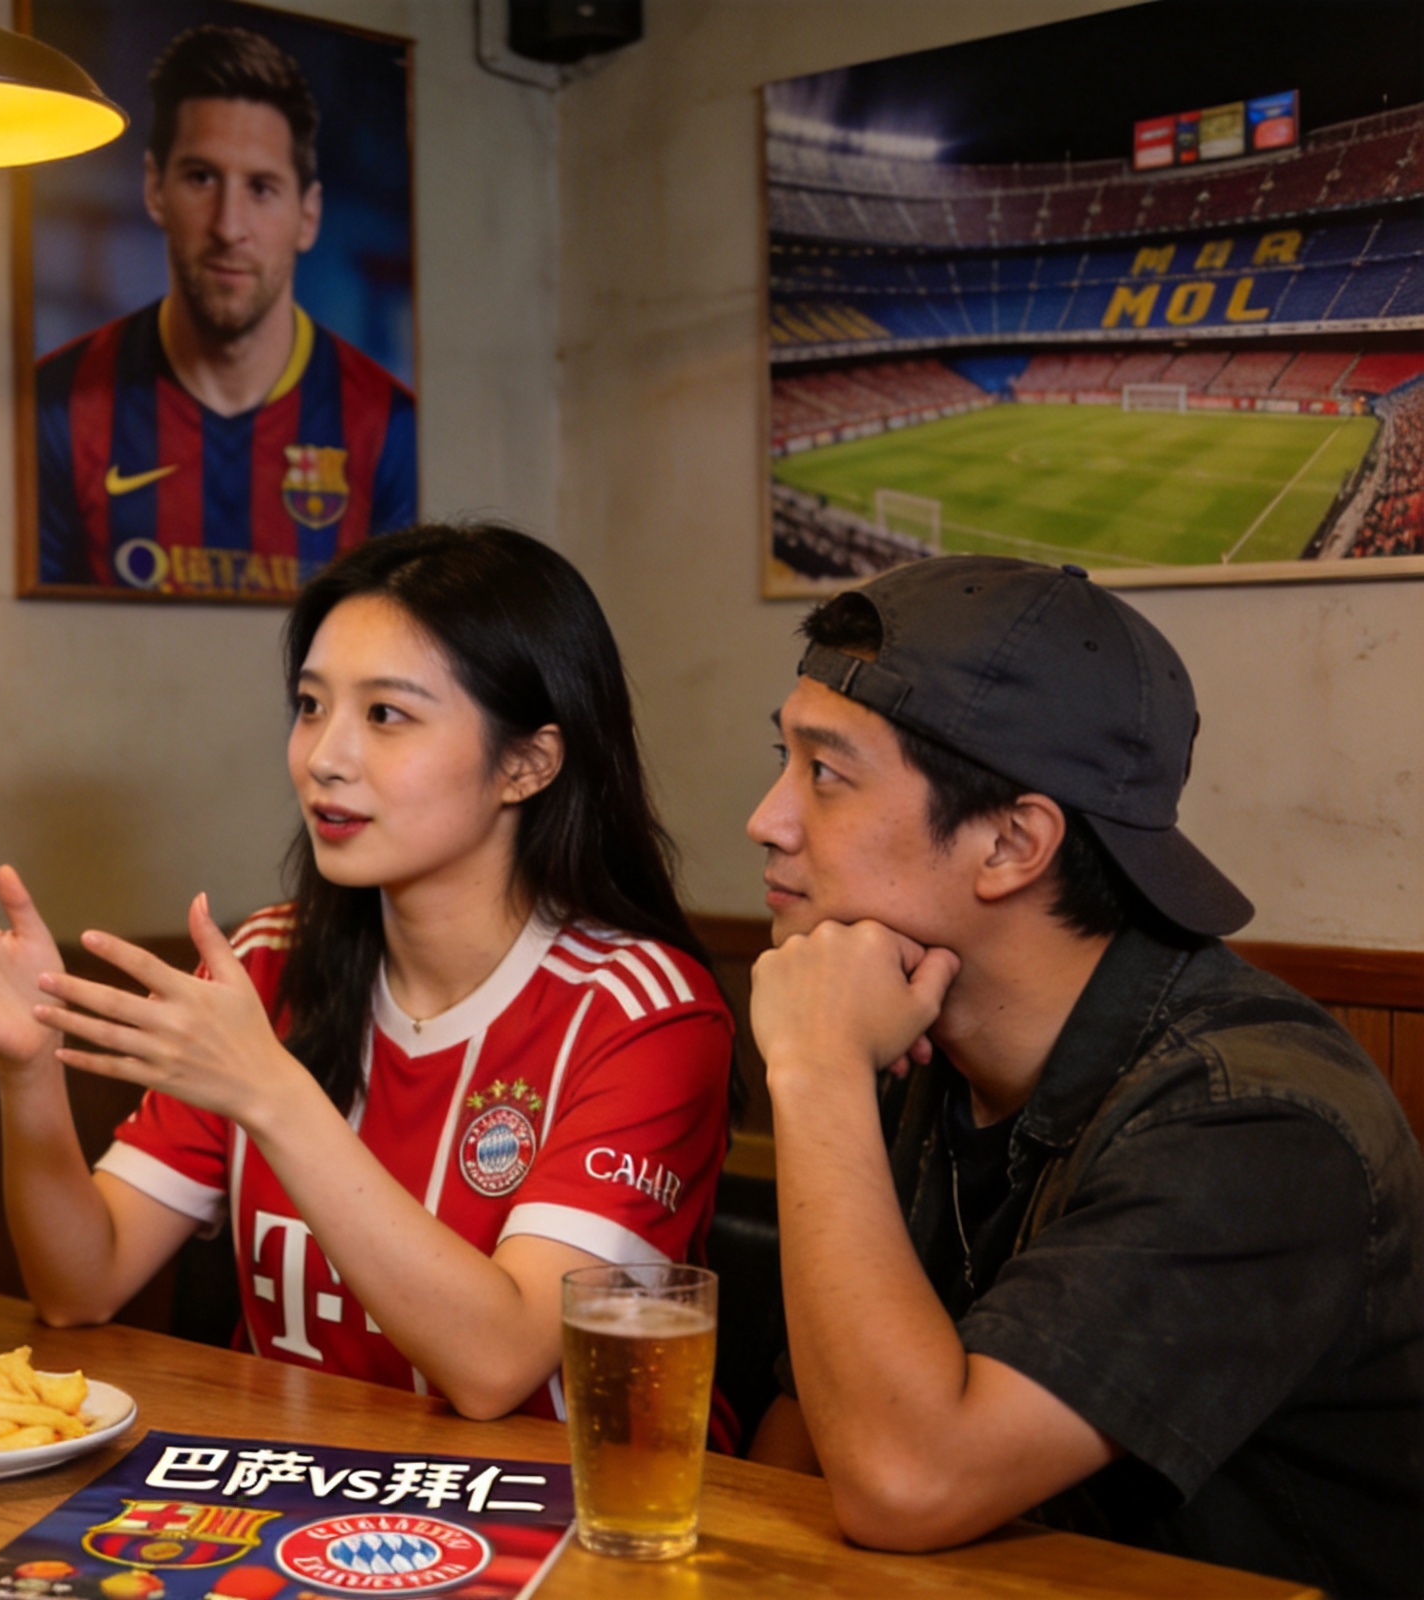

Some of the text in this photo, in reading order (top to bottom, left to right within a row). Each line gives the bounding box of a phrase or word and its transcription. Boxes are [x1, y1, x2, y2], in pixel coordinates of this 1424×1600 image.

[1101, 277, 1269, 328] MOL
[144, 1445, 548, 1513] 巴萨vs拜仁
